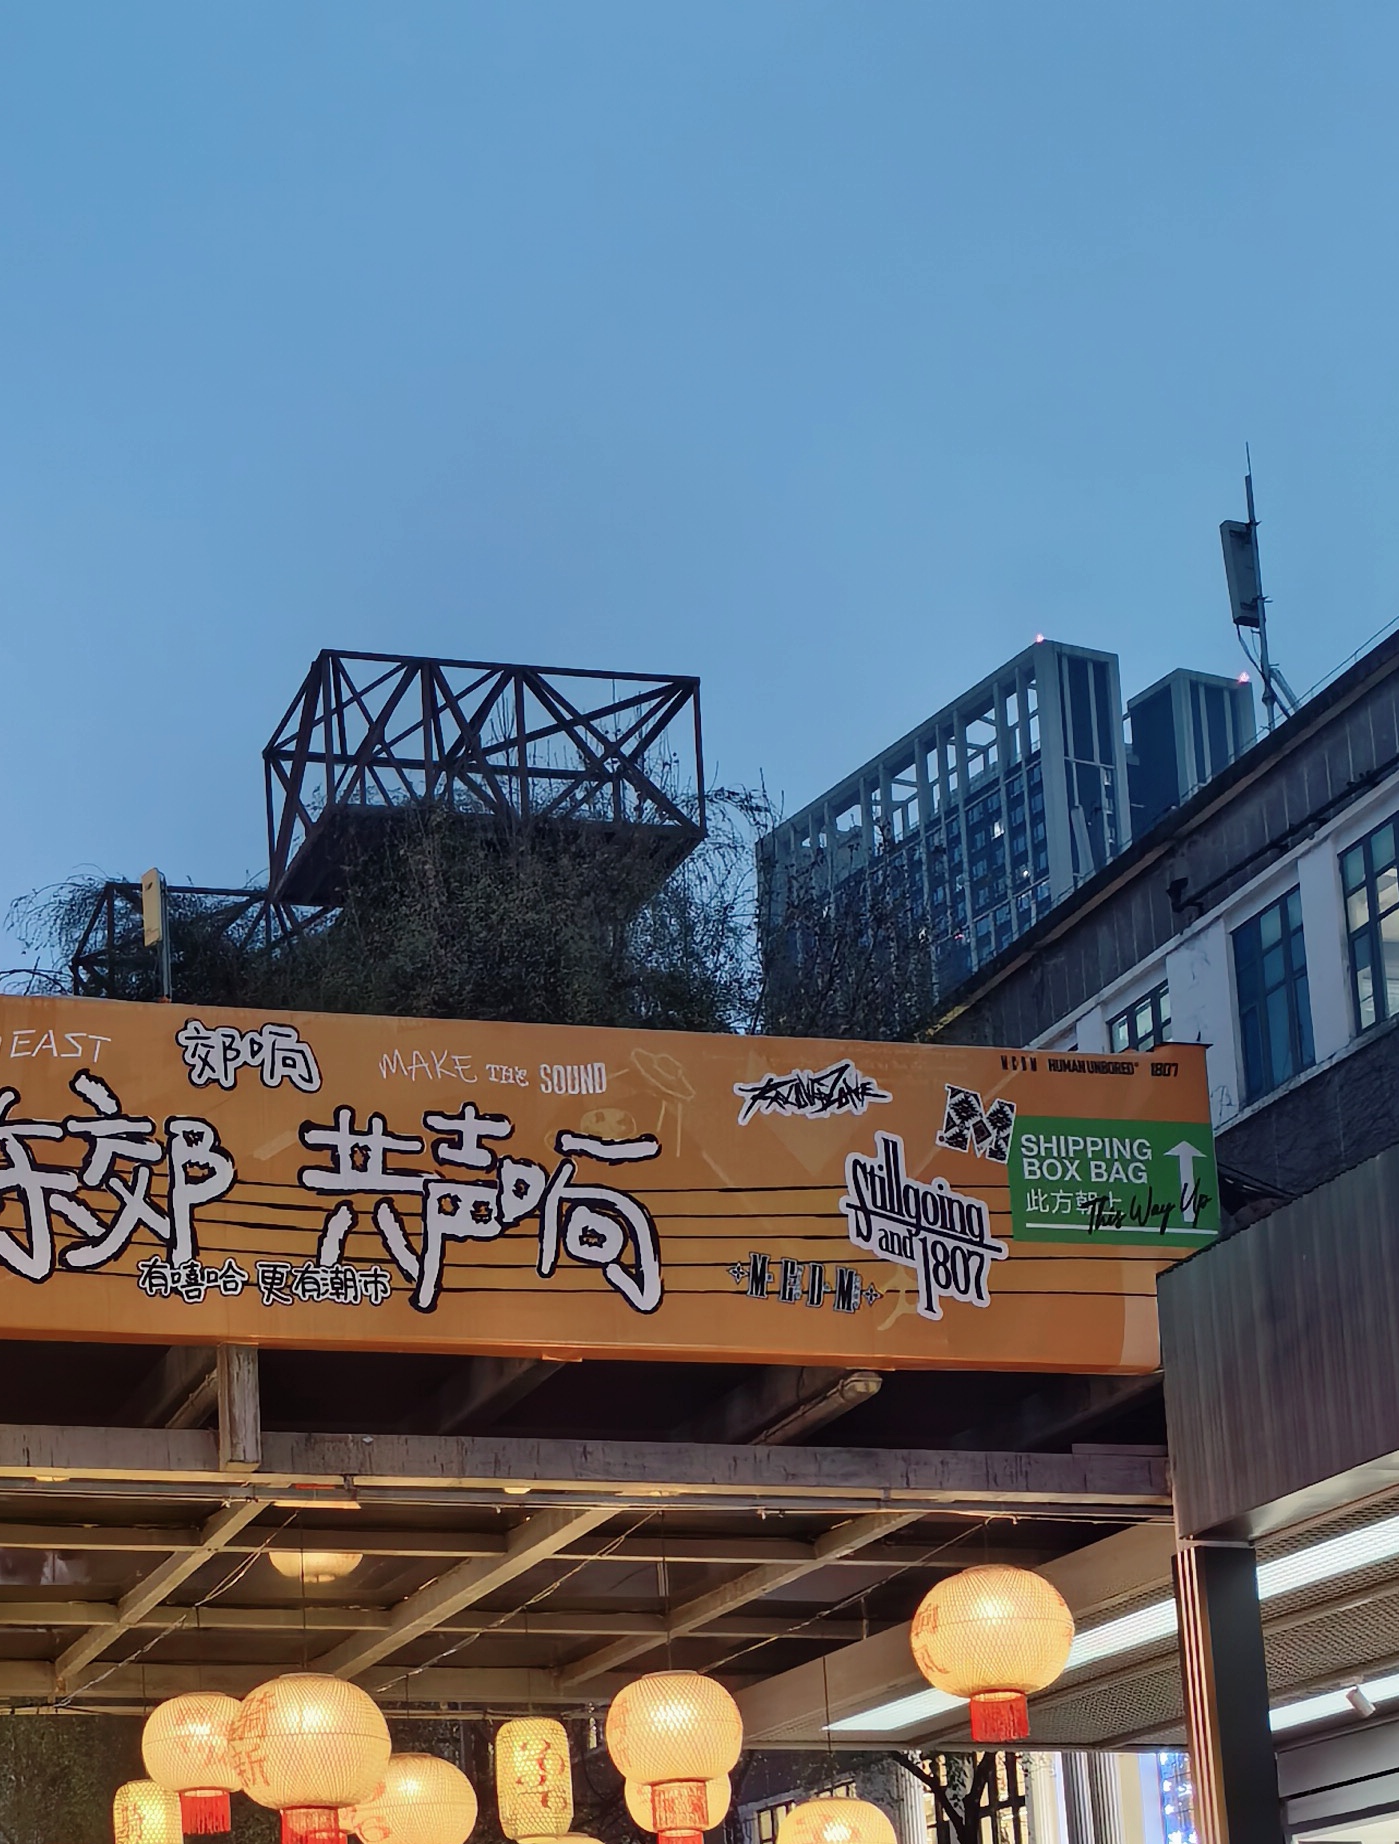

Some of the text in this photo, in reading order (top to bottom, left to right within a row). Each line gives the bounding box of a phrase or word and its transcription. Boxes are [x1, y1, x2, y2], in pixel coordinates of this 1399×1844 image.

[11, 1029, 112, 1063] EAST
[1048, 1059, 1086, 1073] HUMAN
[1150, 1062, 1179, 1077] 1807
[381, 1050, 607, 1095] MAKE THE SOUND
[1020, 1134, 1153, 1161] SHIPPING
[852, 1137, 986, 1248] Still going
[1023, 1158, 1149, 1184] BOX BAG
[298, 1101, 664, 1314] 共声响
[1078, 1195, 1127, 1236] This
[1130, 1185, 1175, 1236] Way
[878, 1228, 918, 1261] and
[138, 1258, 391, 1305] 有嘻哈 更有潮市
[918, 1235, 985, 1314] 1807
